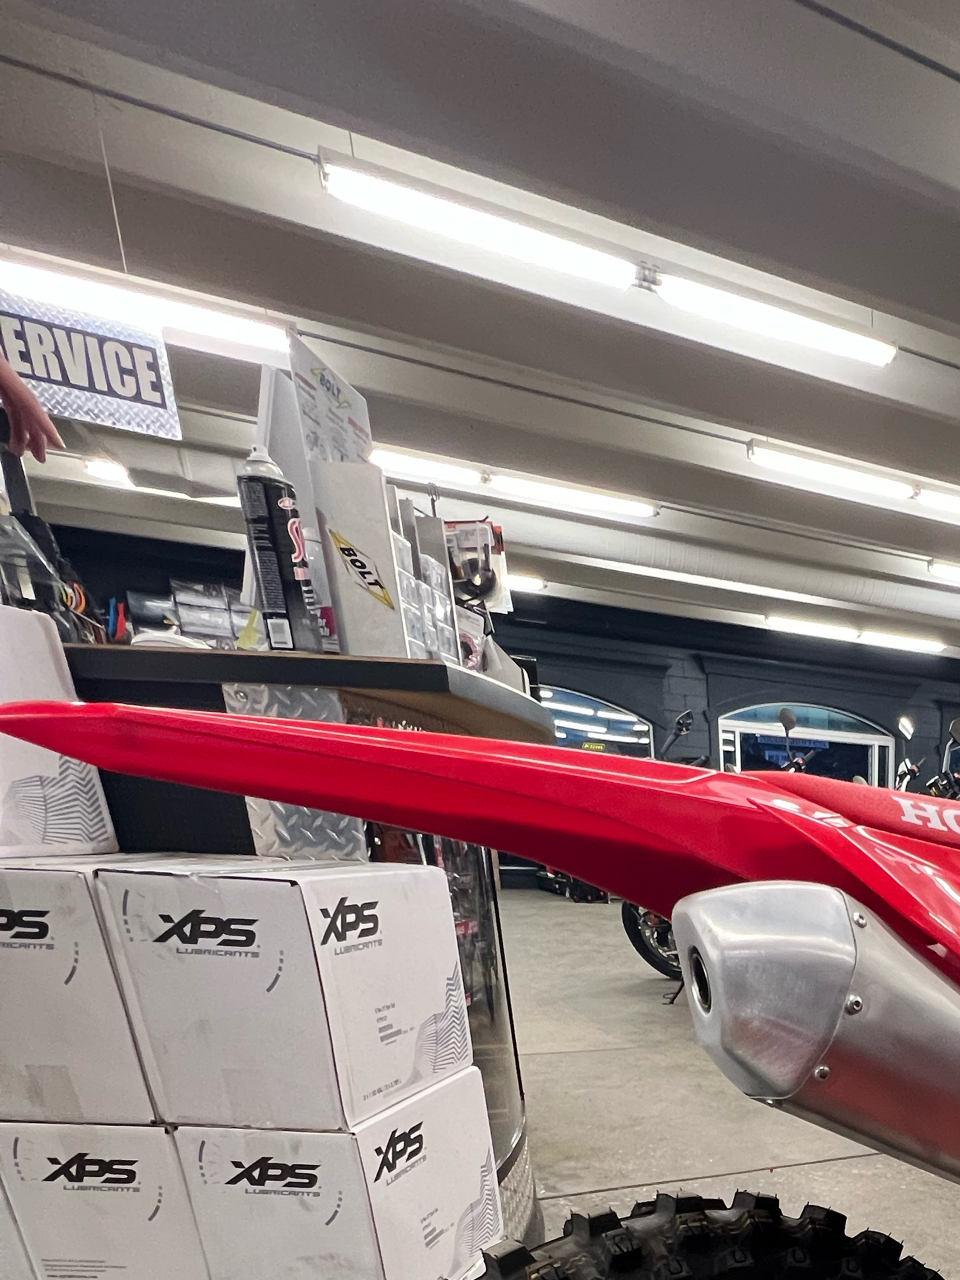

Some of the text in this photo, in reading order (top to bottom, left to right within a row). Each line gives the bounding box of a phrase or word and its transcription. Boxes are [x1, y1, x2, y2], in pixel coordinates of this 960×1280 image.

[0, 315, 163, 404] ERVICE
[339, 546, 385, 590] BOLT
[0, 909, 50, 939] PS
[153, 909, 259, 947] XPS
[319, 896, 379, 946] XPS
[176, 947, 260, 958] LUBRICANTS
[334, 939, 383, 956] LUBRICANTS
[42, 1152, 139, 1184] XPS
[374, 1121, 423, 1183] XPS
[224, 1156, 321, 1188] XPS
[63, 1185, 140, 1193] LUBRICANTS
[245, 1188, 321, 1198] LUBRICANTS
